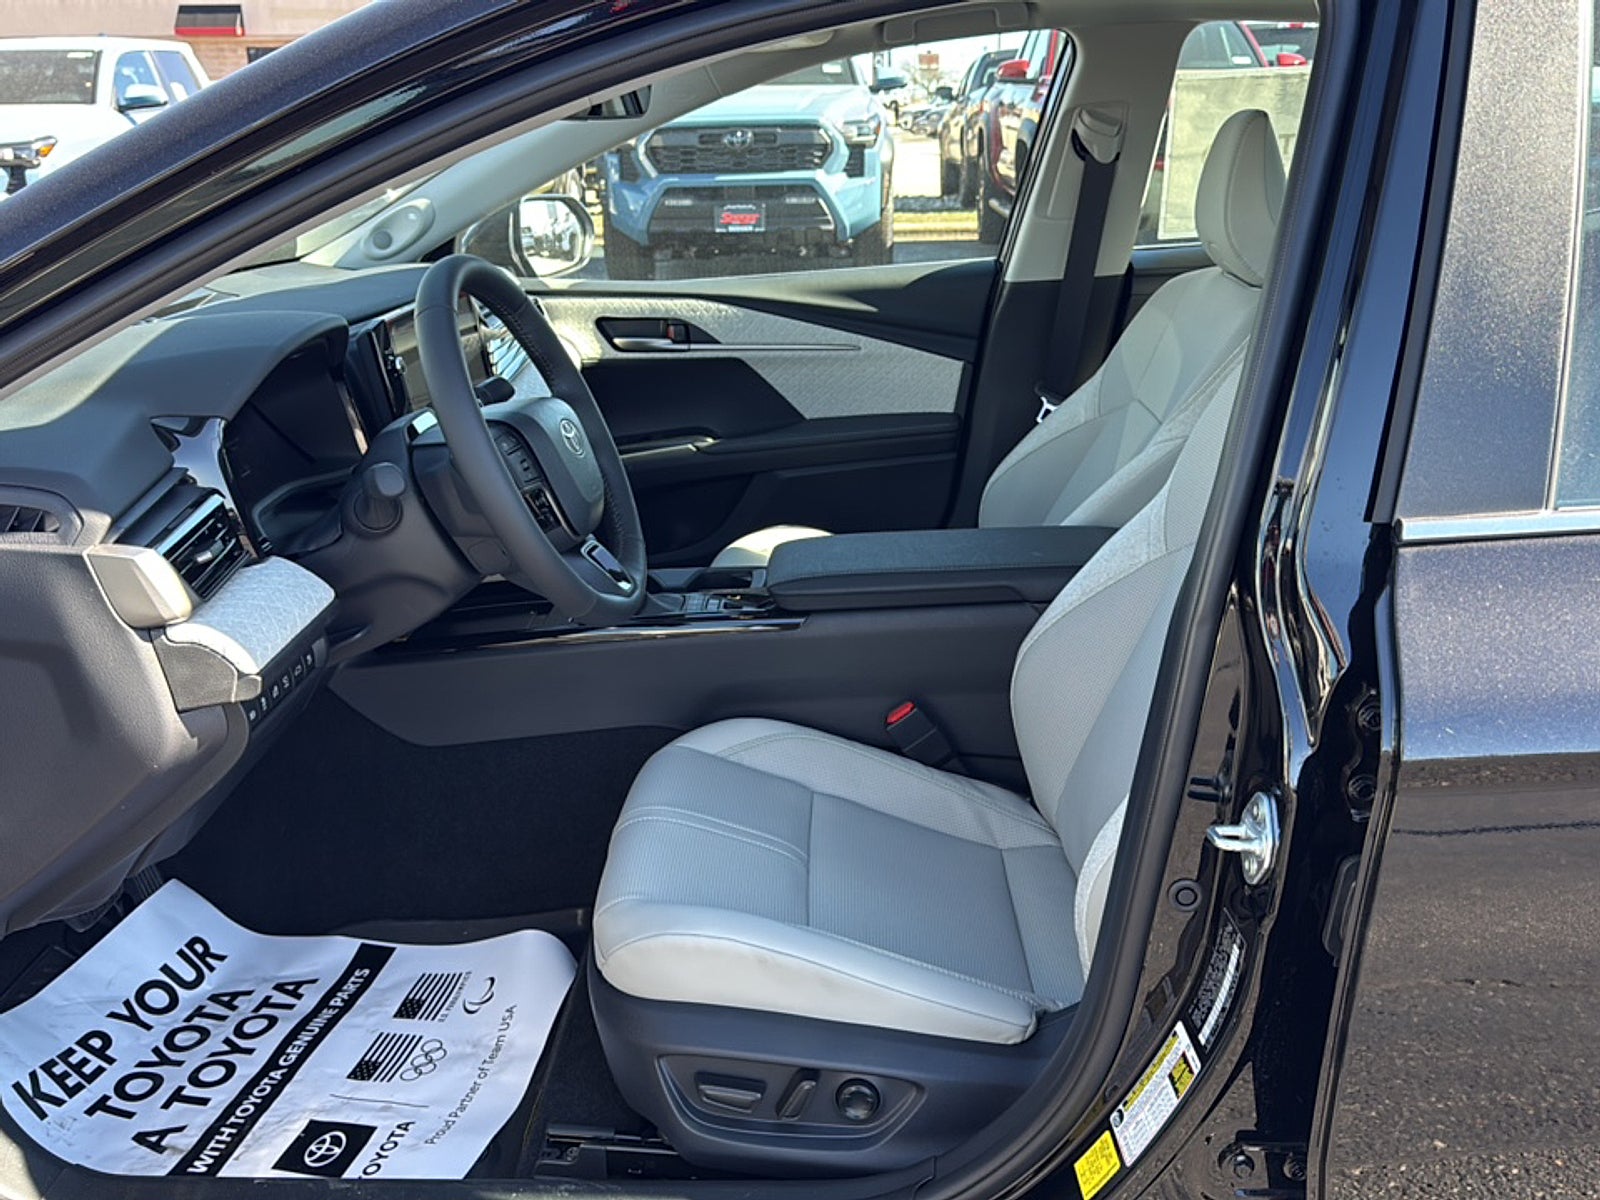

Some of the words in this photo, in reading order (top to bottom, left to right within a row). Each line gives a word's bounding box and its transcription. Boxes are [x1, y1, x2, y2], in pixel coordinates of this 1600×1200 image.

[12, 1030, 117, 1121] KEEP
[105, 936, 228, 1031] YOUR
[498, 1004, 517, 1034] USA
[84, 990, 255, 1119] TOYOTA
[131, 1125, 188, 1154] A
[160, 978, 320, 1110] TOYOTA
[187, 1122, 237, 1174] WITH
[226, 1067, 285, 1130] TOYOTA
[280, 1007, 338, 1069] GENUINE
[331, 967, 372, 1008] PARTS
[477, 1060, 490, 1080] of
[483, 1034, 506, 1065] Team
[448, 1081, 482, 1118] Partner
[358, 1121, 416, 1179] OYOTA
[424, 1119, 456, 1145] Proud
